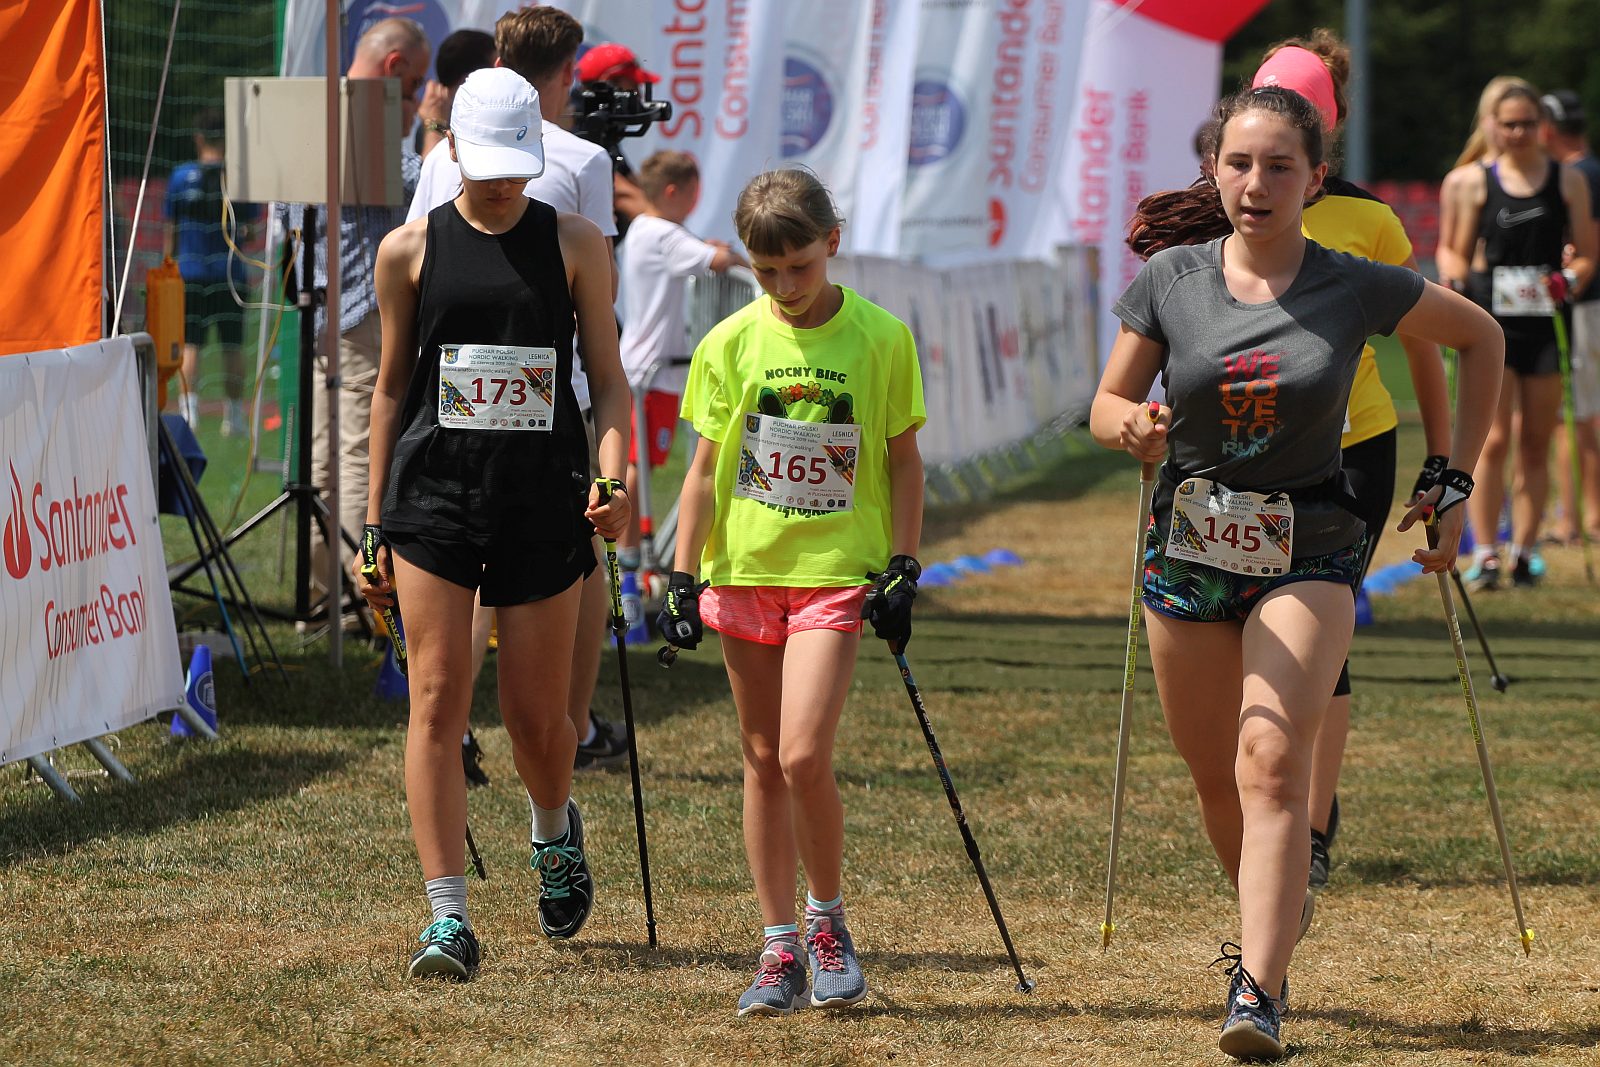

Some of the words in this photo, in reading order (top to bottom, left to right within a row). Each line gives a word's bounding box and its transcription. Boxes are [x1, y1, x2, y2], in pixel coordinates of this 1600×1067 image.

[765, 367, 811, 380] NOCNY
[816, 369, 847, 384] BIEG
[1224, 353, 1281, 380] WE
[471, 377, 527, 406] 173
[770, 427, 791, 435] NORDIC
[792, 429, 821, 438] WALKING
[773, 421, 797, 429] PUCHAR
[798, 424, 818, 432] POLSKI
[1221, 419, 1275, 441] TO
[767, 451, 827, 485] 165
[31, 469, 136, 571] Santander
[1203, 516, 1261, 552] 145
[1131, 586, 1142, 632] FLASH
[45, 597, 105, 660] Consumer
[1125, 635, 1139, 691] CARBON
